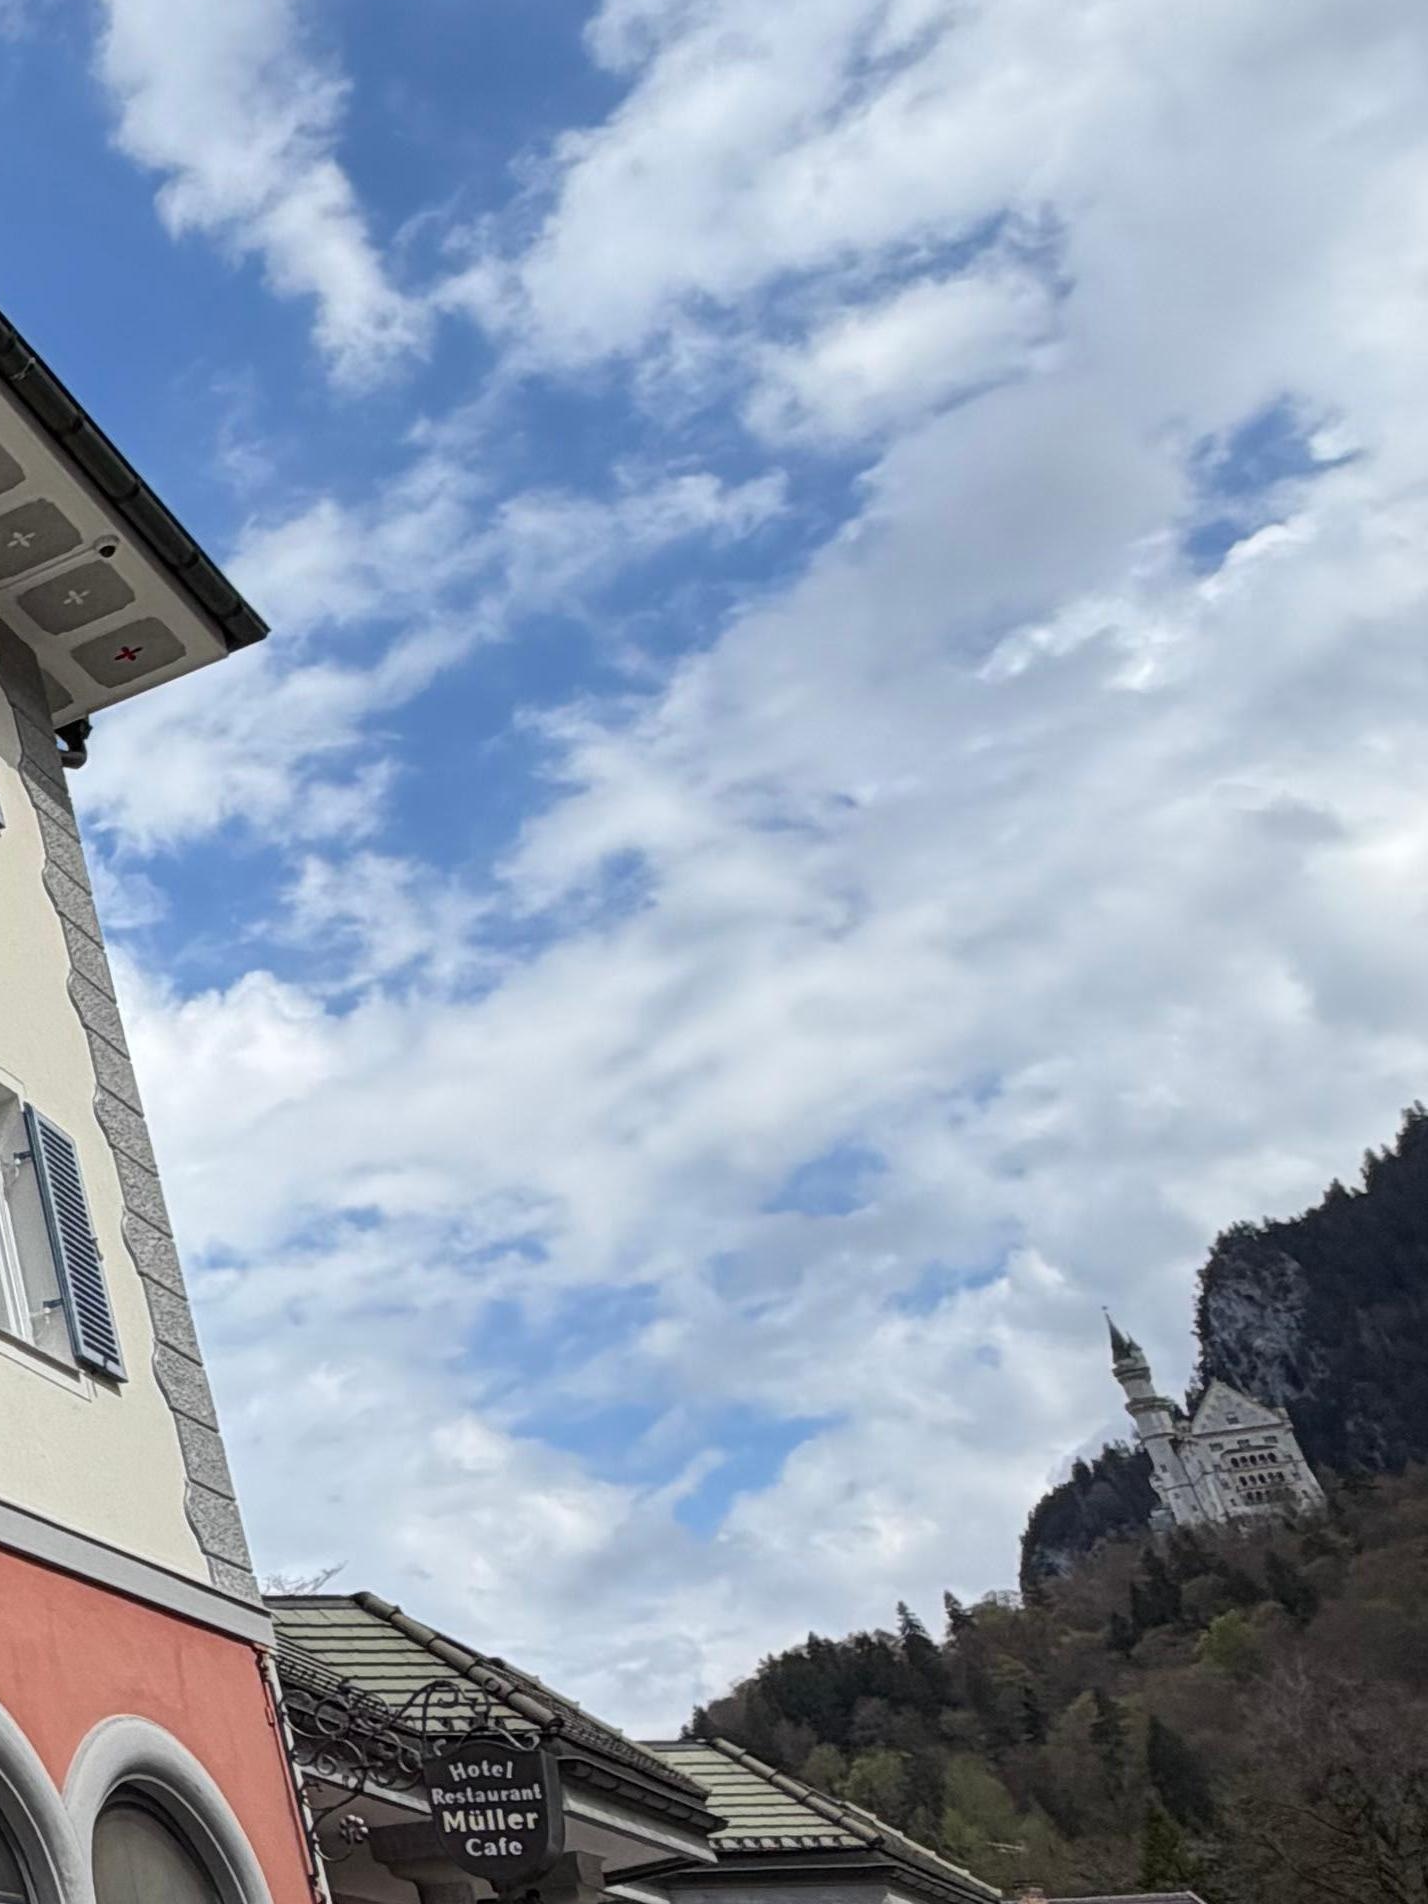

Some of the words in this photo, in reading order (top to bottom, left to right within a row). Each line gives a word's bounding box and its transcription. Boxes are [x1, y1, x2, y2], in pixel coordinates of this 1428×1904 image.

[448, 1760, 513, 1782] Hotel
[431, 1783, 542, 1805] Restaurant
[442, 1808, 539, 1833] Müller
[465, 1837, 523, 1856] Cafe
